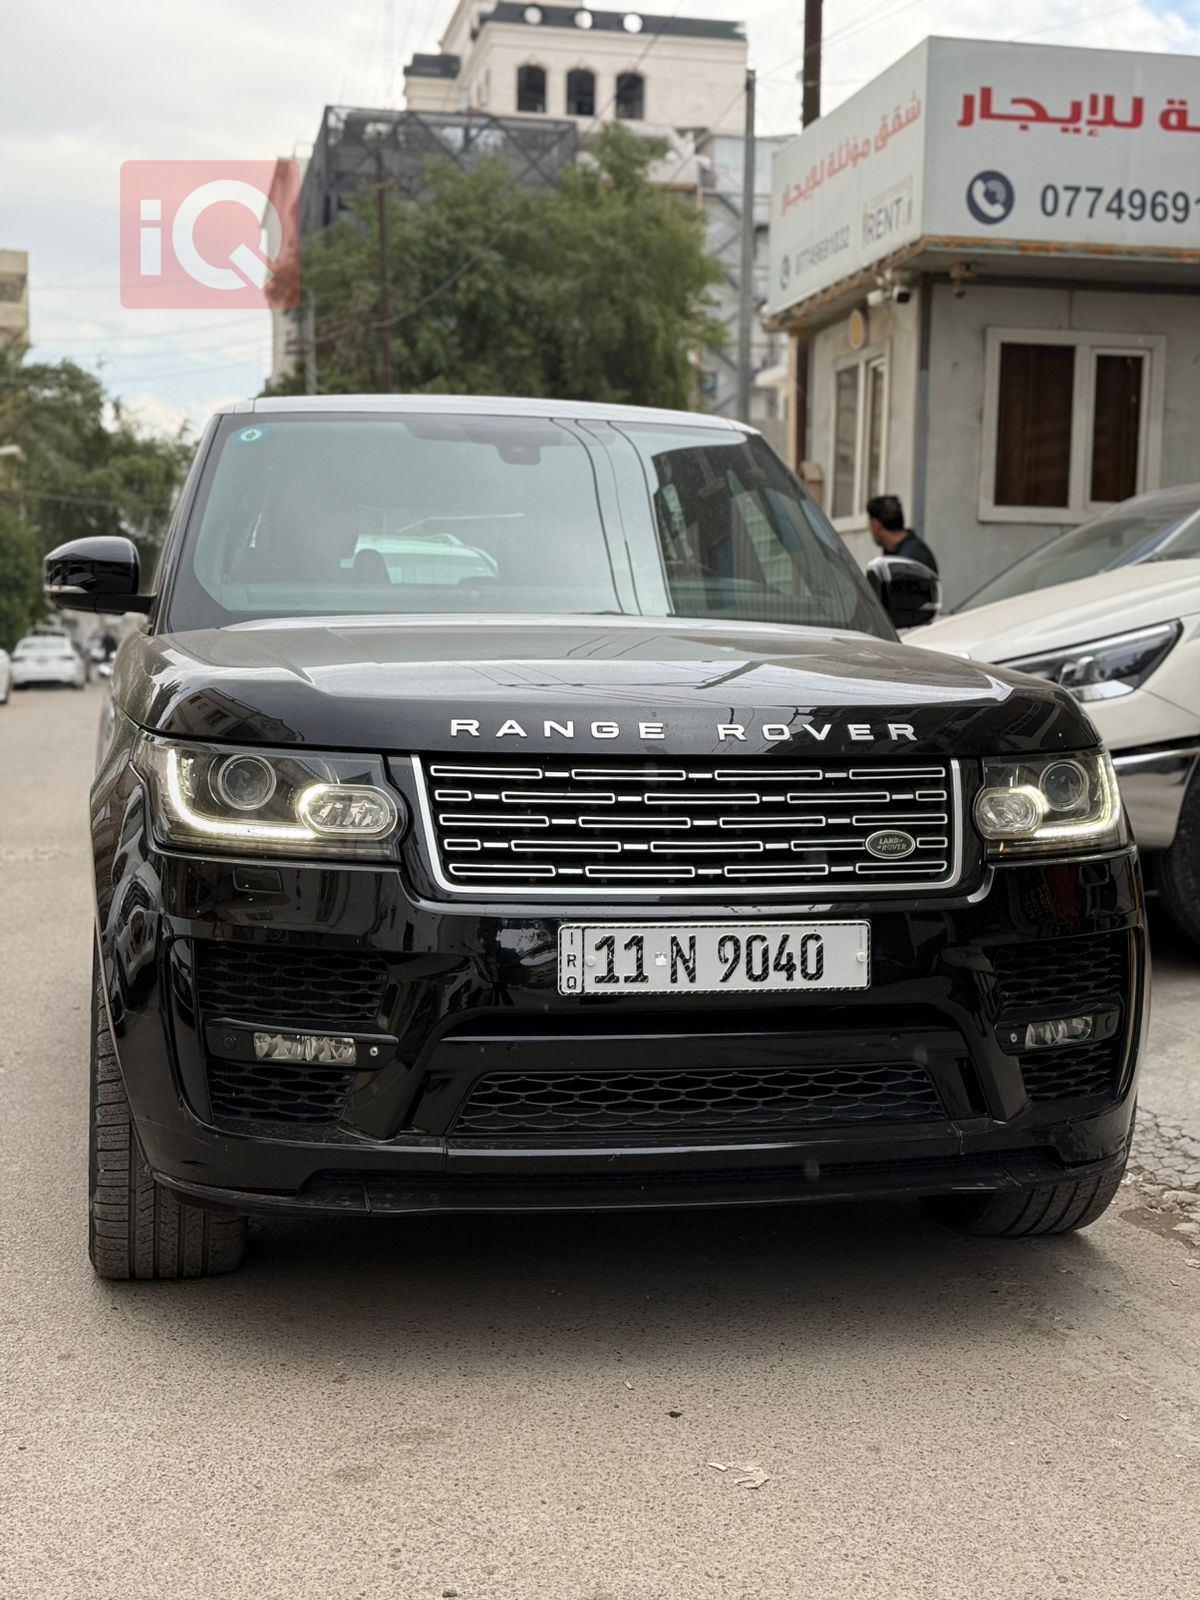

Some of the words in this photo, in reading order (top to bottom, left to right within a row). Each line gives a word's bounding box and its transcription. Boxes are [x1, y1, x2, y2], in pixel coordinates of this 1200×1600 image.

[957, 86, 1144, 137] للإيجار
[449, 718, 666, 740] RANGE
[716, 722, 919, 742] ROVER
[879, 837, 899, 845] LAND
[881, 843, 907, 851] ROVER
[594, 934, 649, 984] 11
[670, 934, 697, 984] N
[717, 932, 825, 983] 9040
